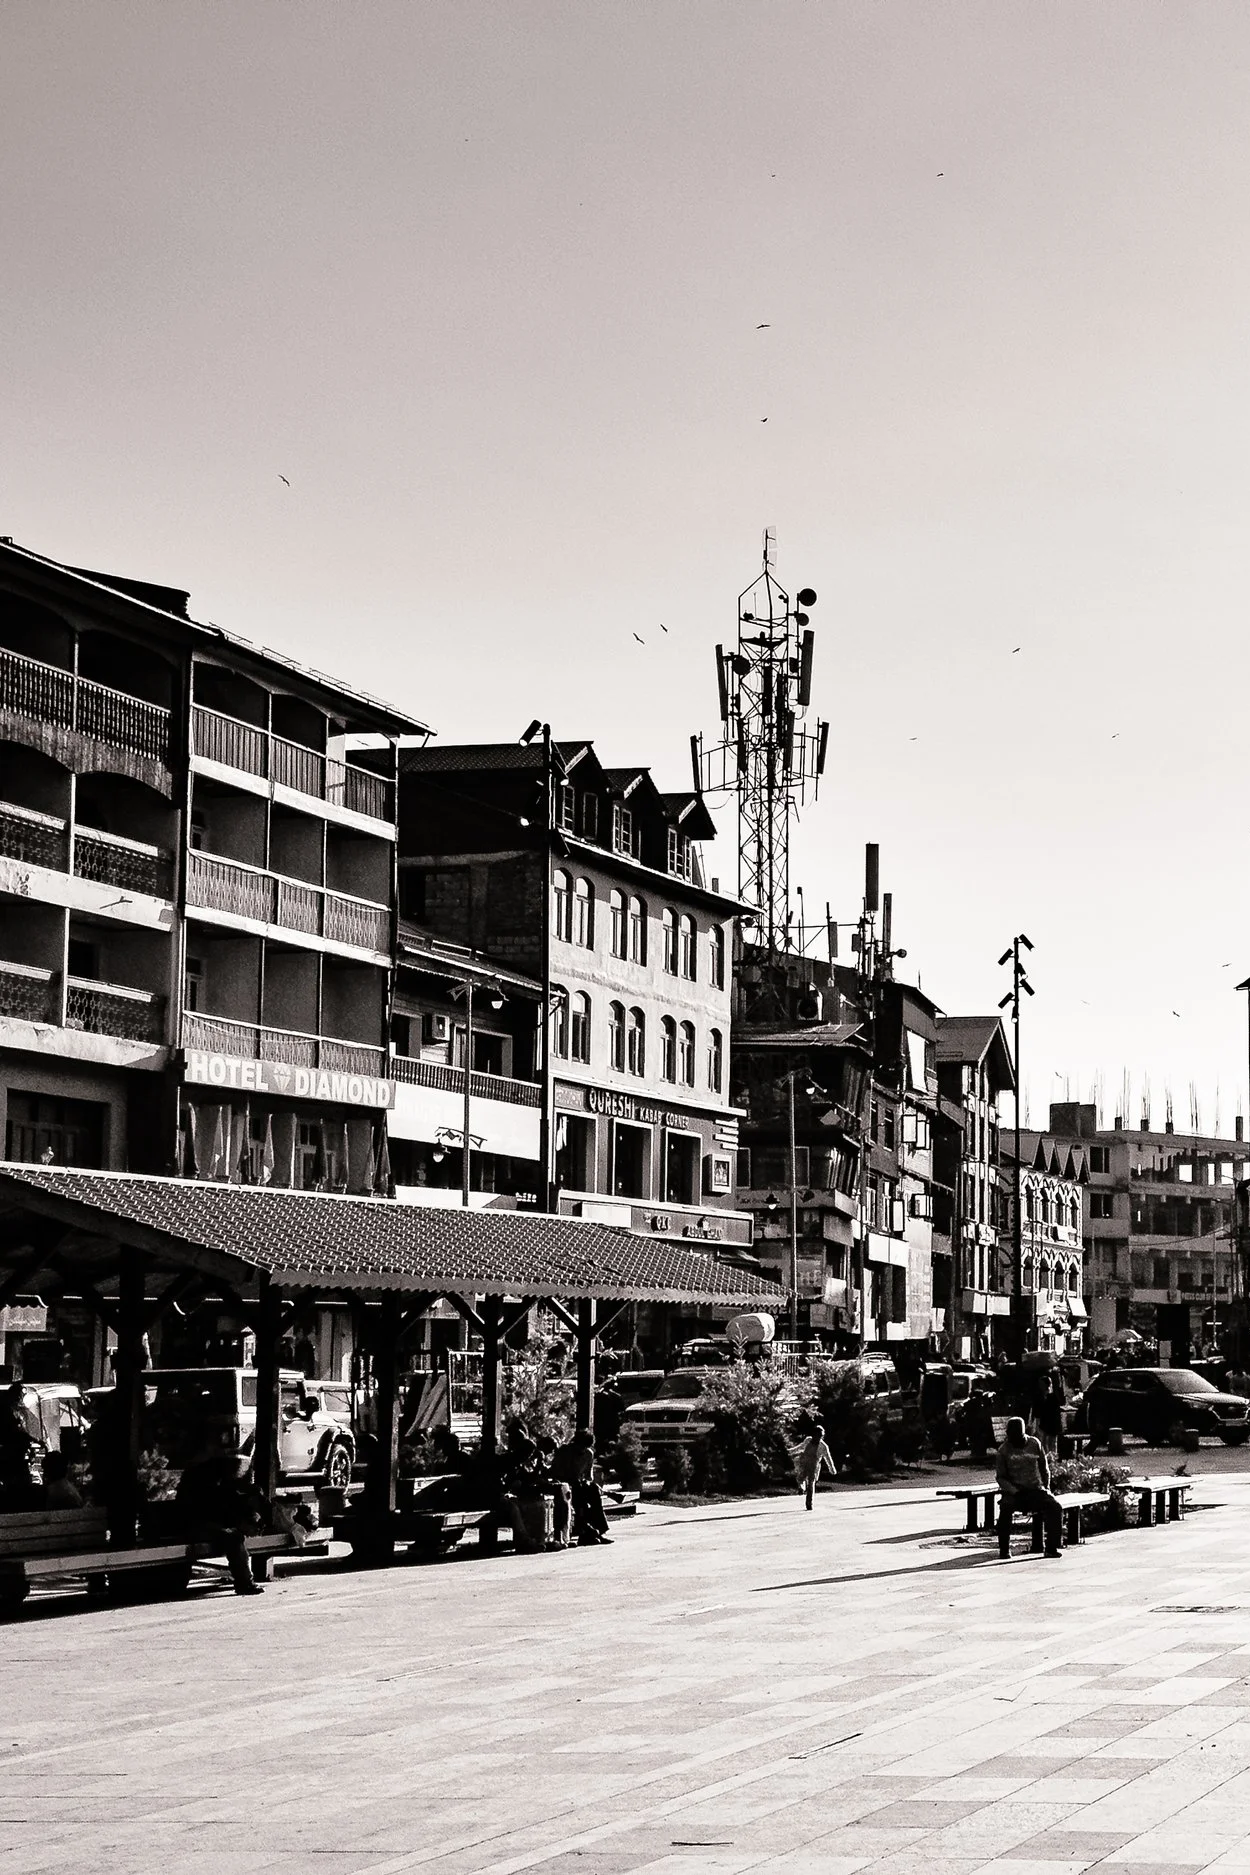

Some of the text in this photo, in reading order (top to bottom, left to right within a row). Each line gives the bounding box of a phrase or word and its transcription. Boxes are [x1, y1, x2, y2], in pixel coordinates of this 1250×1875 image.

[191, 1052, 391, 1108] HOTEL DIAMOND
[589, 1087, 636, 1120] QURESHI
